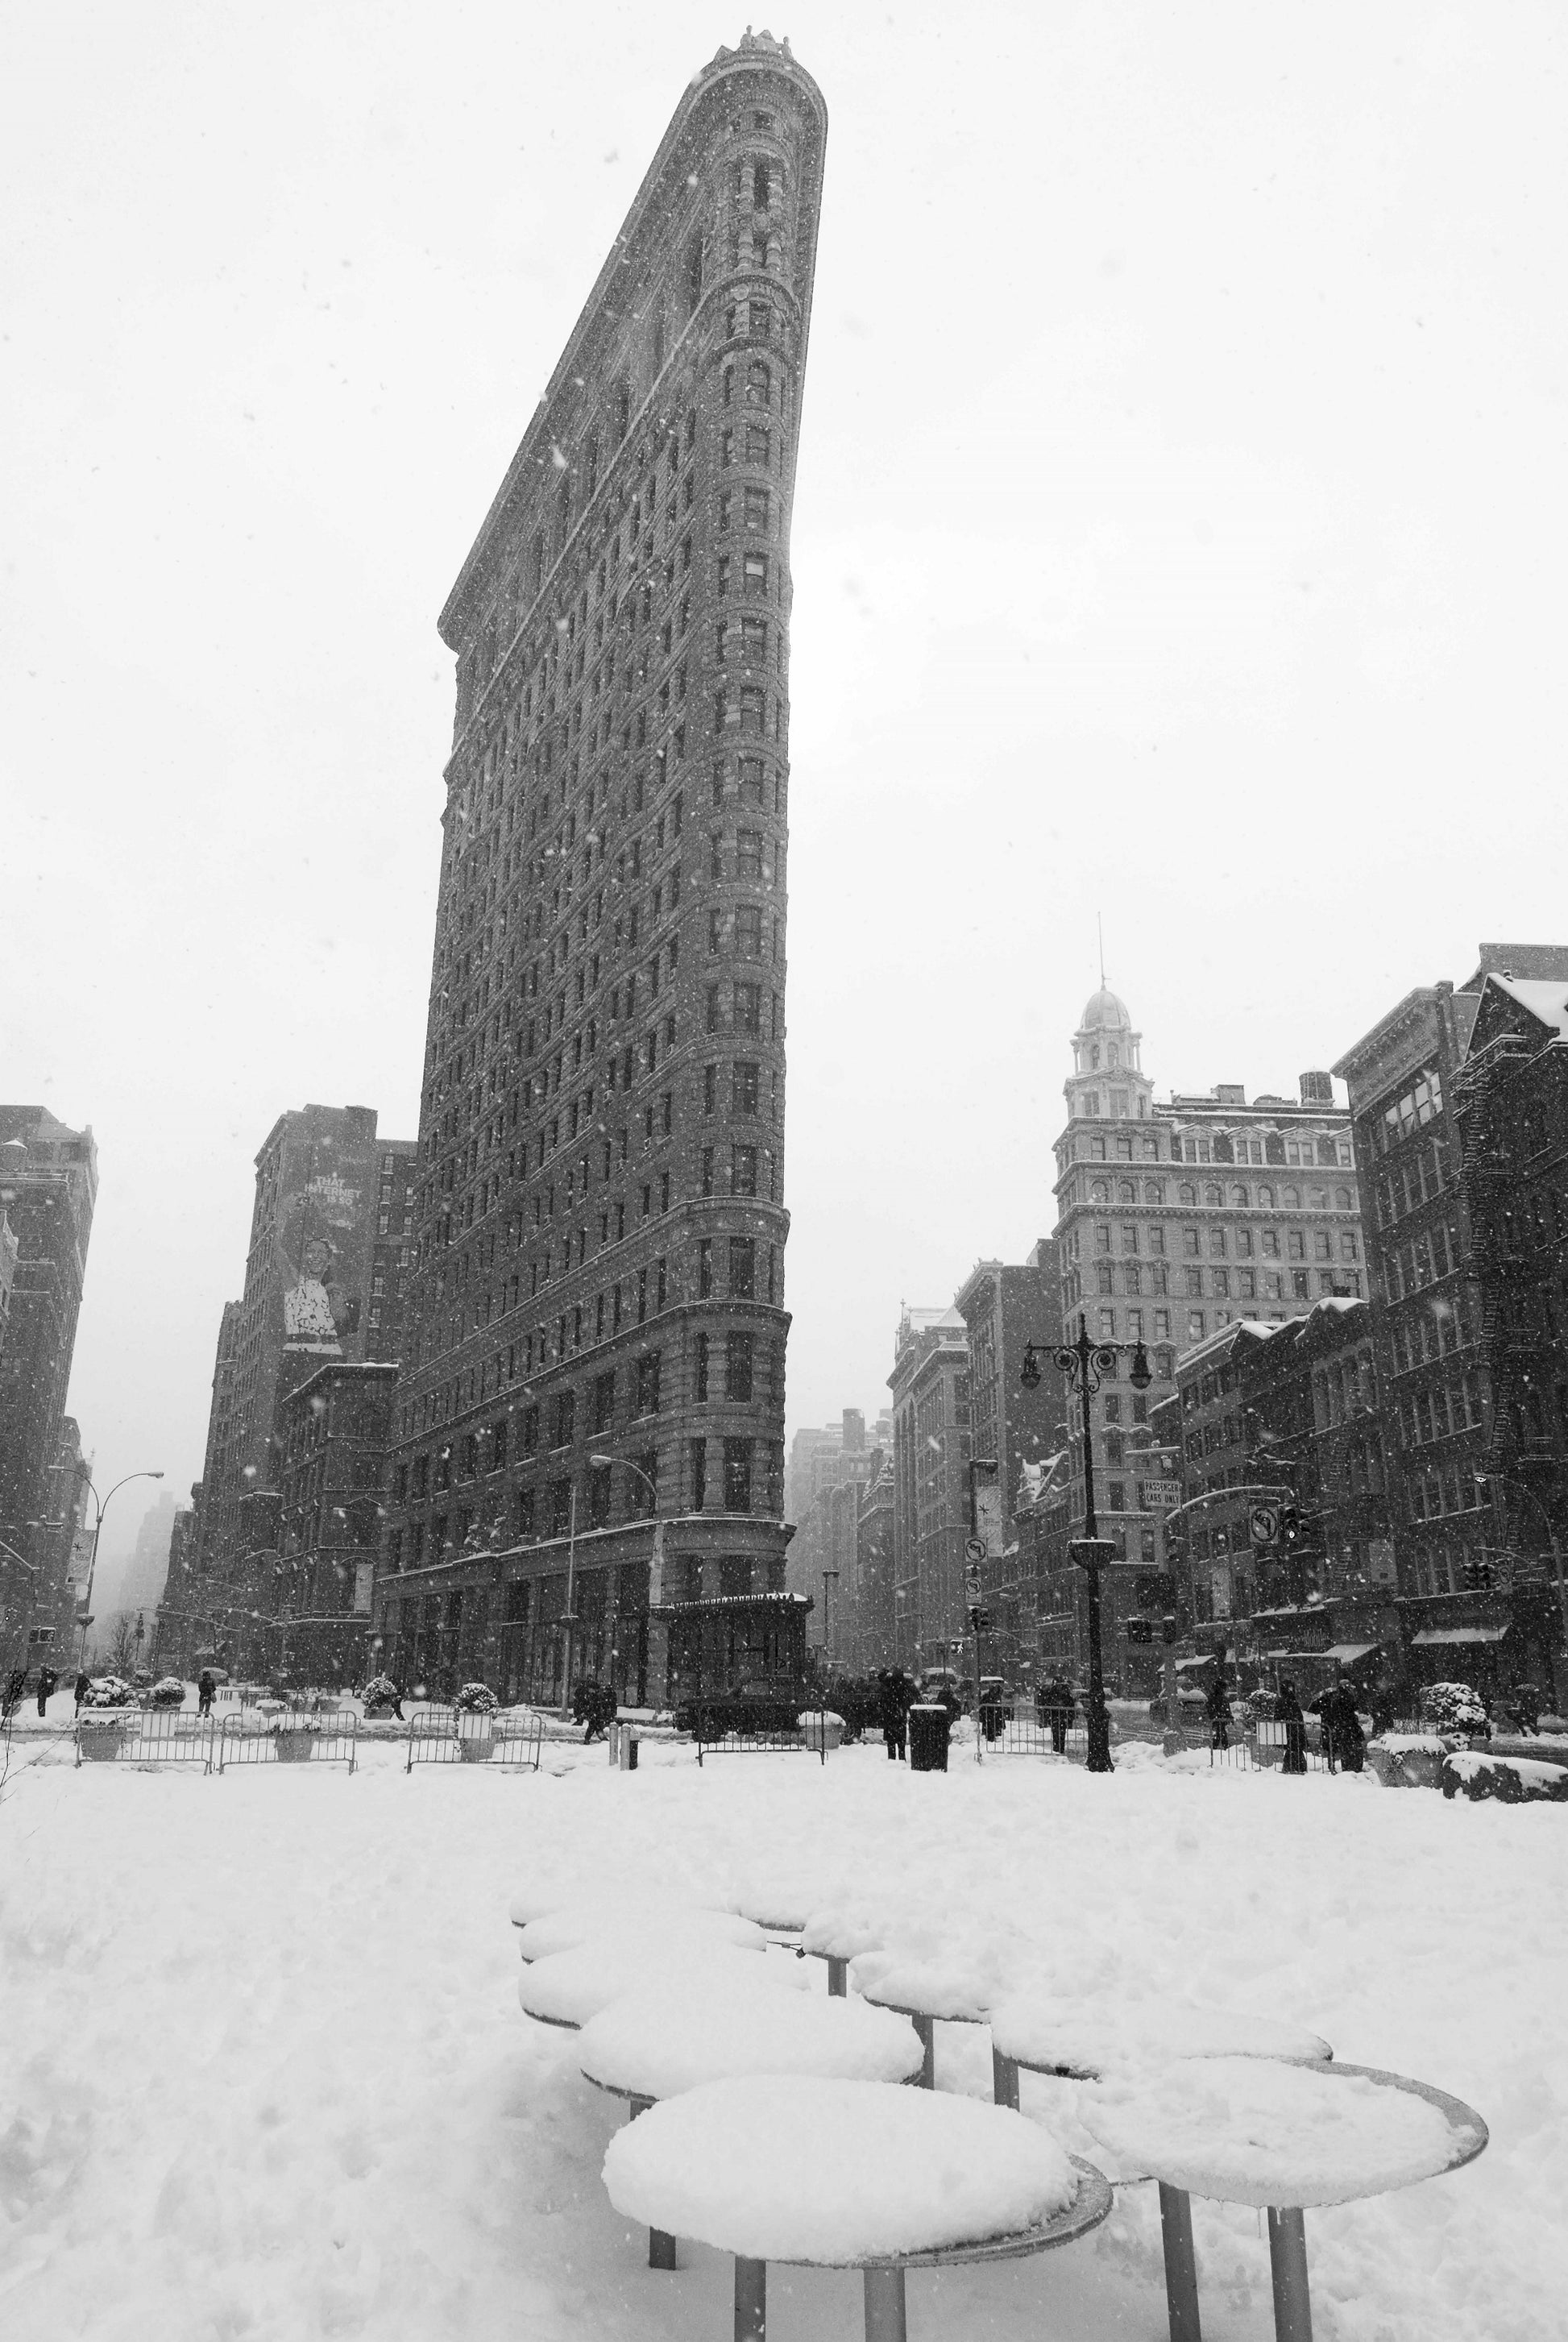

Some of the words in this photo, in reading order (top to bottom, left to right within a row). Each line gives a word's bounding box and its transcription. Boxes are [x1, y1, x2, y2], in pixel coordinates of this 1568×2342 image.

[314, 1175, 346, 1188] THAT
[338, 1196, 353, 1206] SO
[1145, 1481, 1179, 1492] PASSENGER
[1146, 1493, 1161, 1502] CARS
[1164, 1494, 1179, 1504] ONLY
